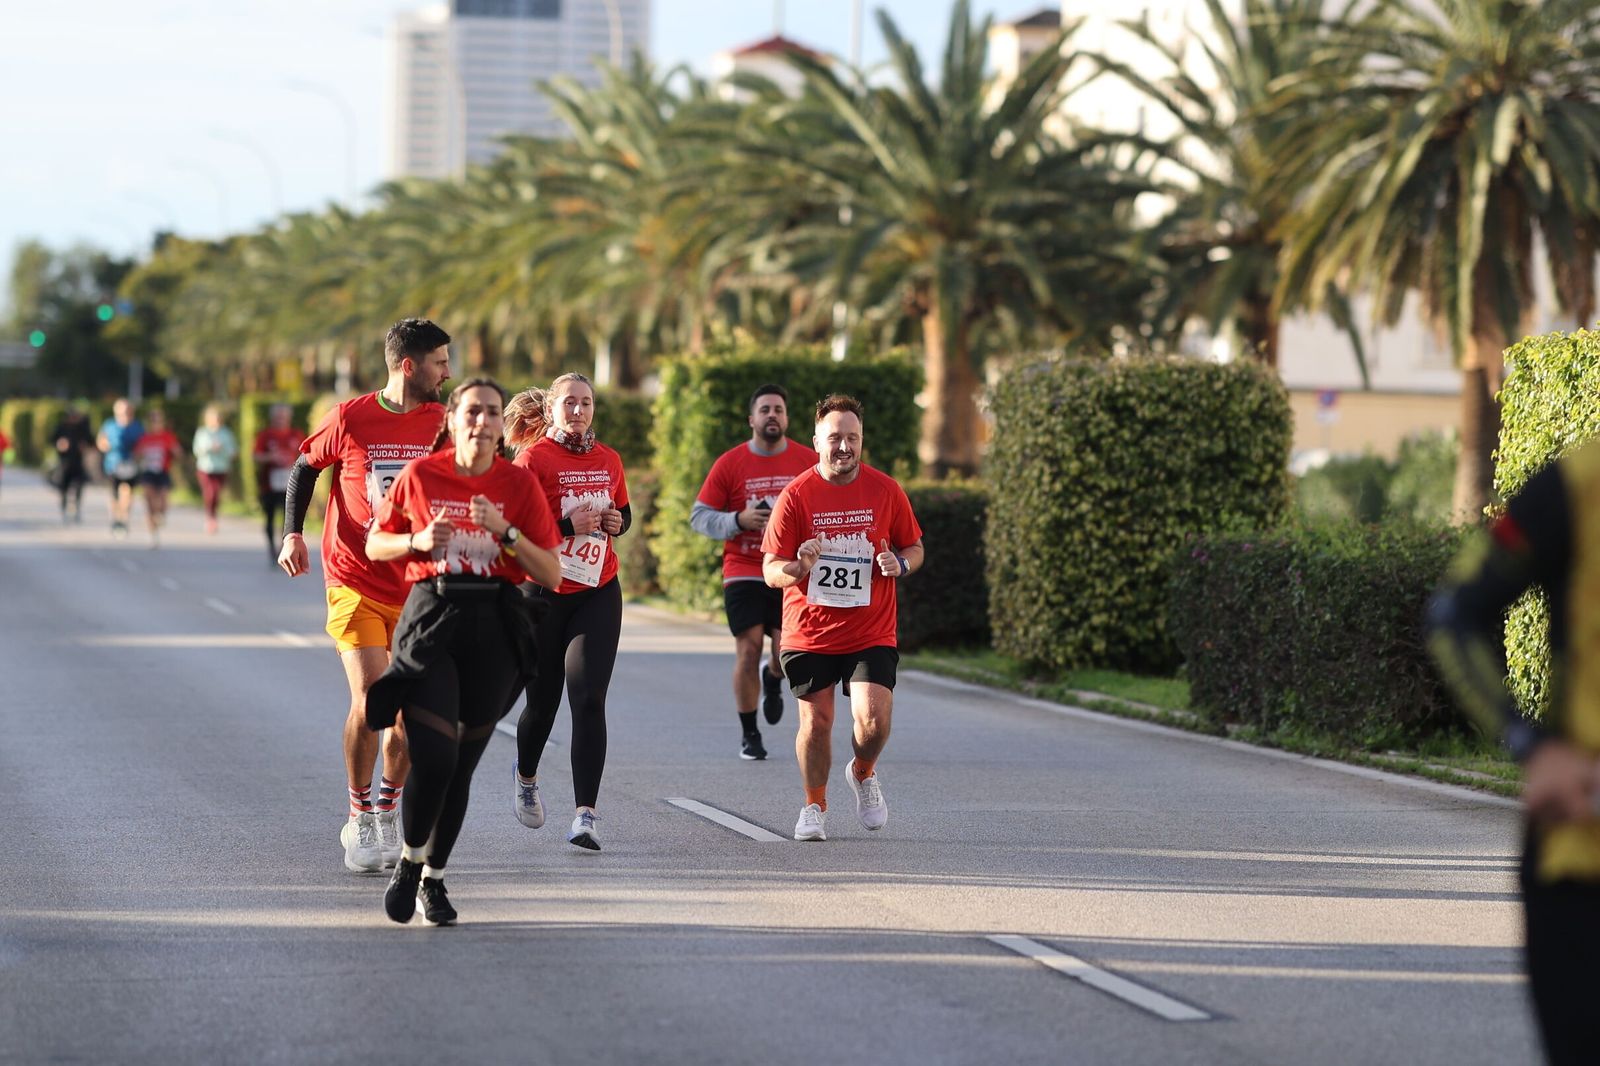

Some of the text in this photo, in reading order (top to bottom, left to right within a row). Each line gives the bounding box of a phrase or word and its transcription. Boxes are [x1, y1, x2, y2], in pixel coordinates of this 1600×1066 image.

[367, 450, 400, 458] CIUDAD
[559, 475, 587, 484] CIUDAD
[429, 506, 467, 518] CIDAD
[812, 513, 873, 526] CIUDAD JARDÍN
[560, 536, 601, 566] 149
[817, 565, 863, 590] 281
